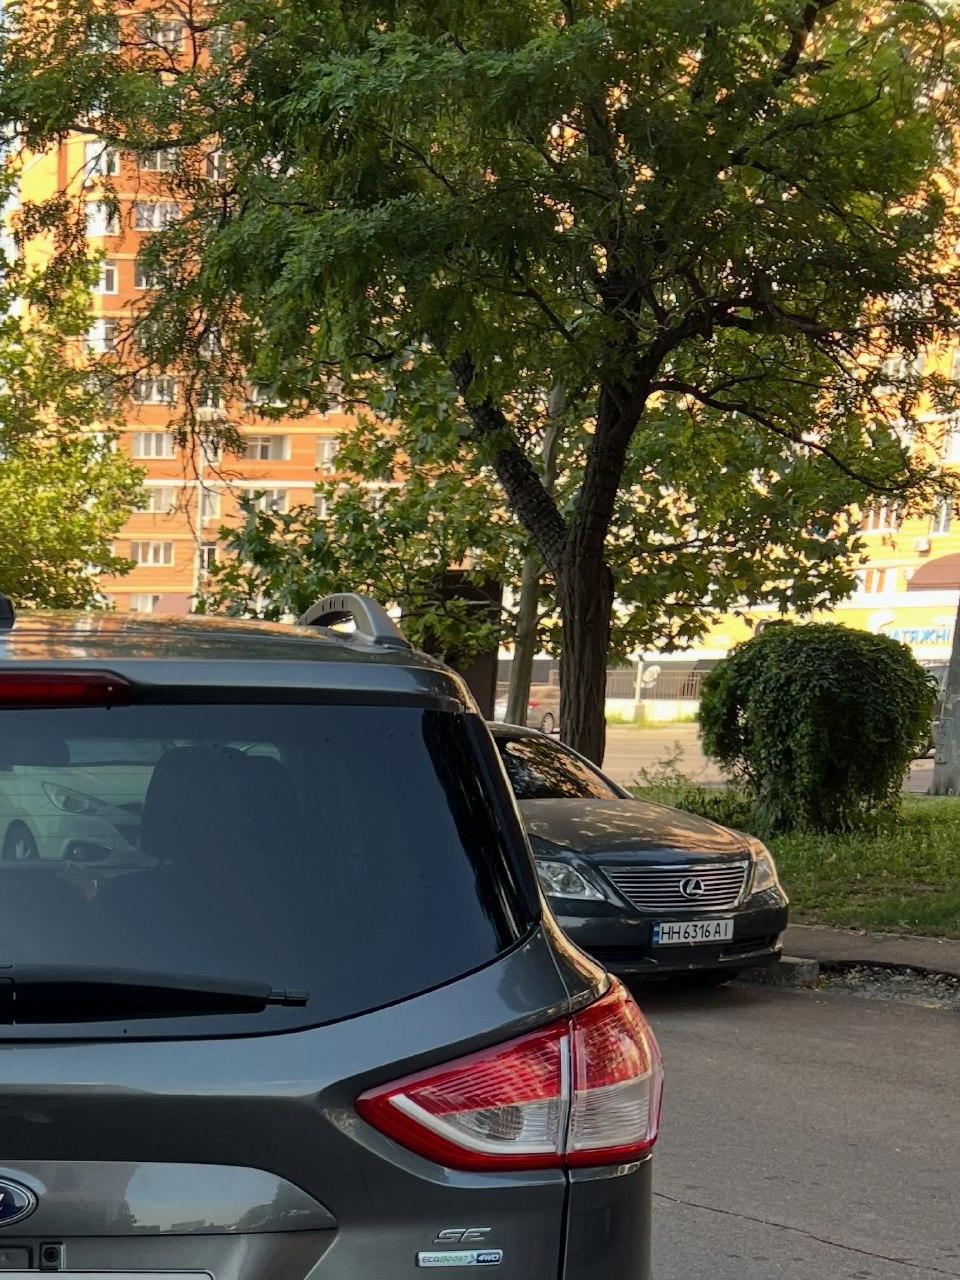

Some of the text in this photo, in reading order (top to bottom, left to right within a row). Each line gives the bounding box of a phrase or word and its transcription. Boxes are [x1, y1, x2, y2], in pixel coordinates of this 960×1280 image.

[661, 922, 728, 940] HH 6316 AI
[433, 1227, 492, 1244] SE
[478, 1254, 500, 1262] 4WD
